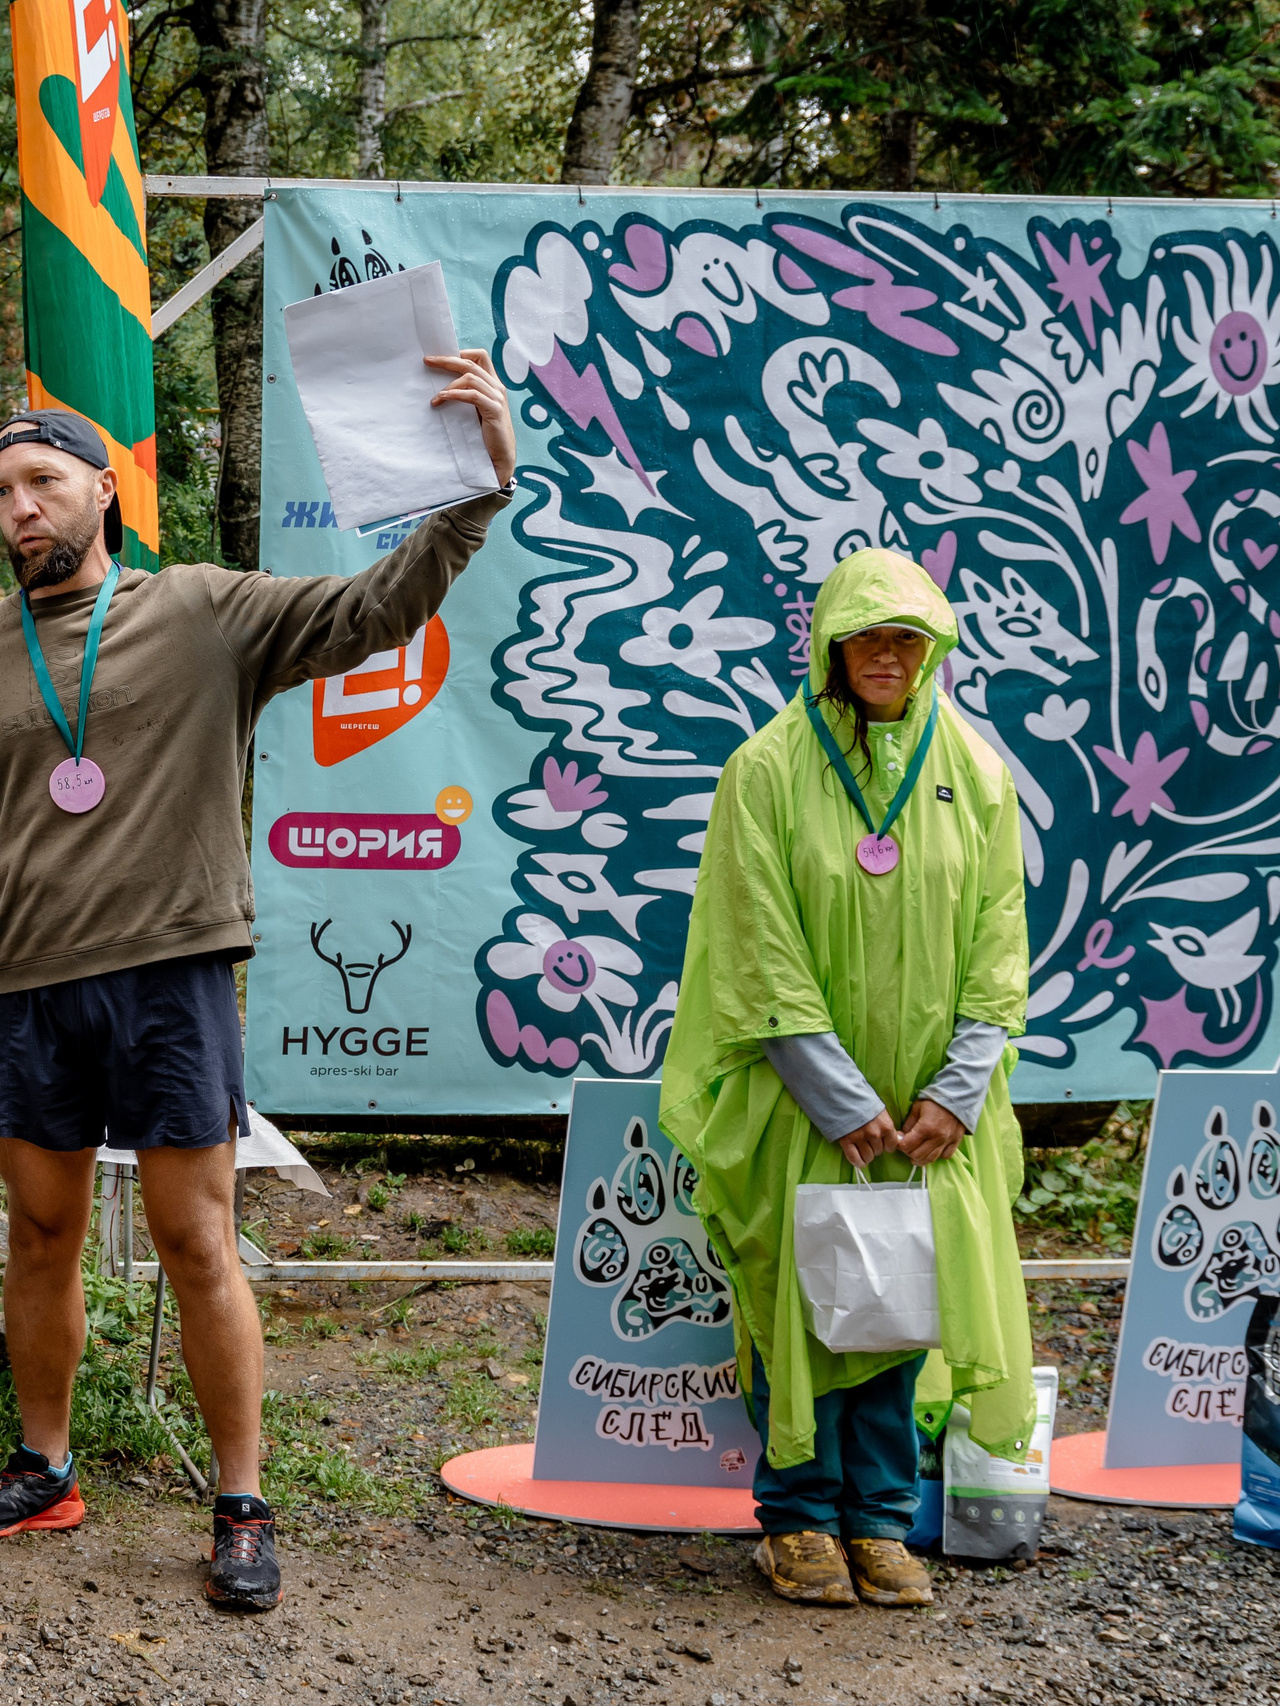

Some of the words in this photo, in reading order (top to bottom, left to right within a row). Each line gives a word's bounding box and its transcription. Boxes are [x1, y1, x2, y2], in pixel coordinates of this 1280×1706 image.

[56, 774, 82, 790] 58,5
[288, 827, 443, 859] ШОРИЯ
[862, 844, 884, 859] 54,6
[282, 1026, 430, 1057] HYGGE
[310, 1065, 372, 1078] apres-ski
[376, 1065, 399, 1076] bar
[1148, 1342, 1246, 1381] СИБИРС
[575, 1360, 738, 1403] СИБИРСКИЙ
[1171, 1387, 1245, 1423] СЛЁ
[602, 1409, 710, 1447] СЛЁД
